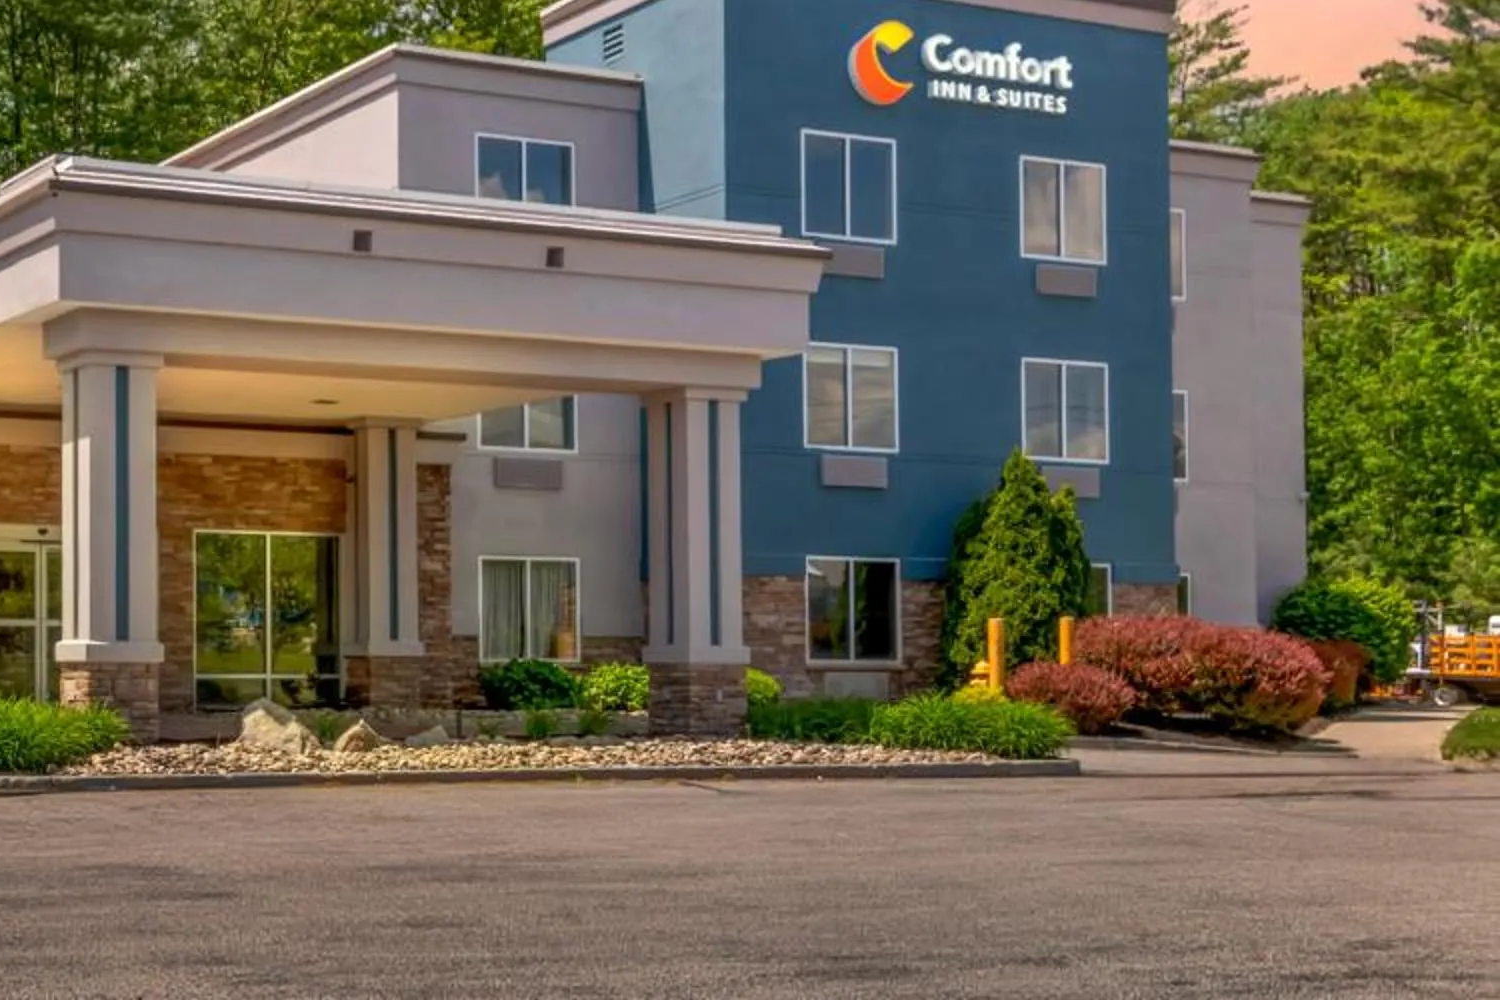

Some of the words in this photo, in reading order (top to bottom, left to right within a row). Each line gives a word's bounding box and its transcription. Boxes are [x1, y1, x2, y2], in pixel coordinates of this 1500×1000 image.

[921, 33, 1074, 90] Comfort
[928, 79, 972, 101] INN
[976, 85, 991, 103] &
[996, 87, 1068, 114] SUITES
